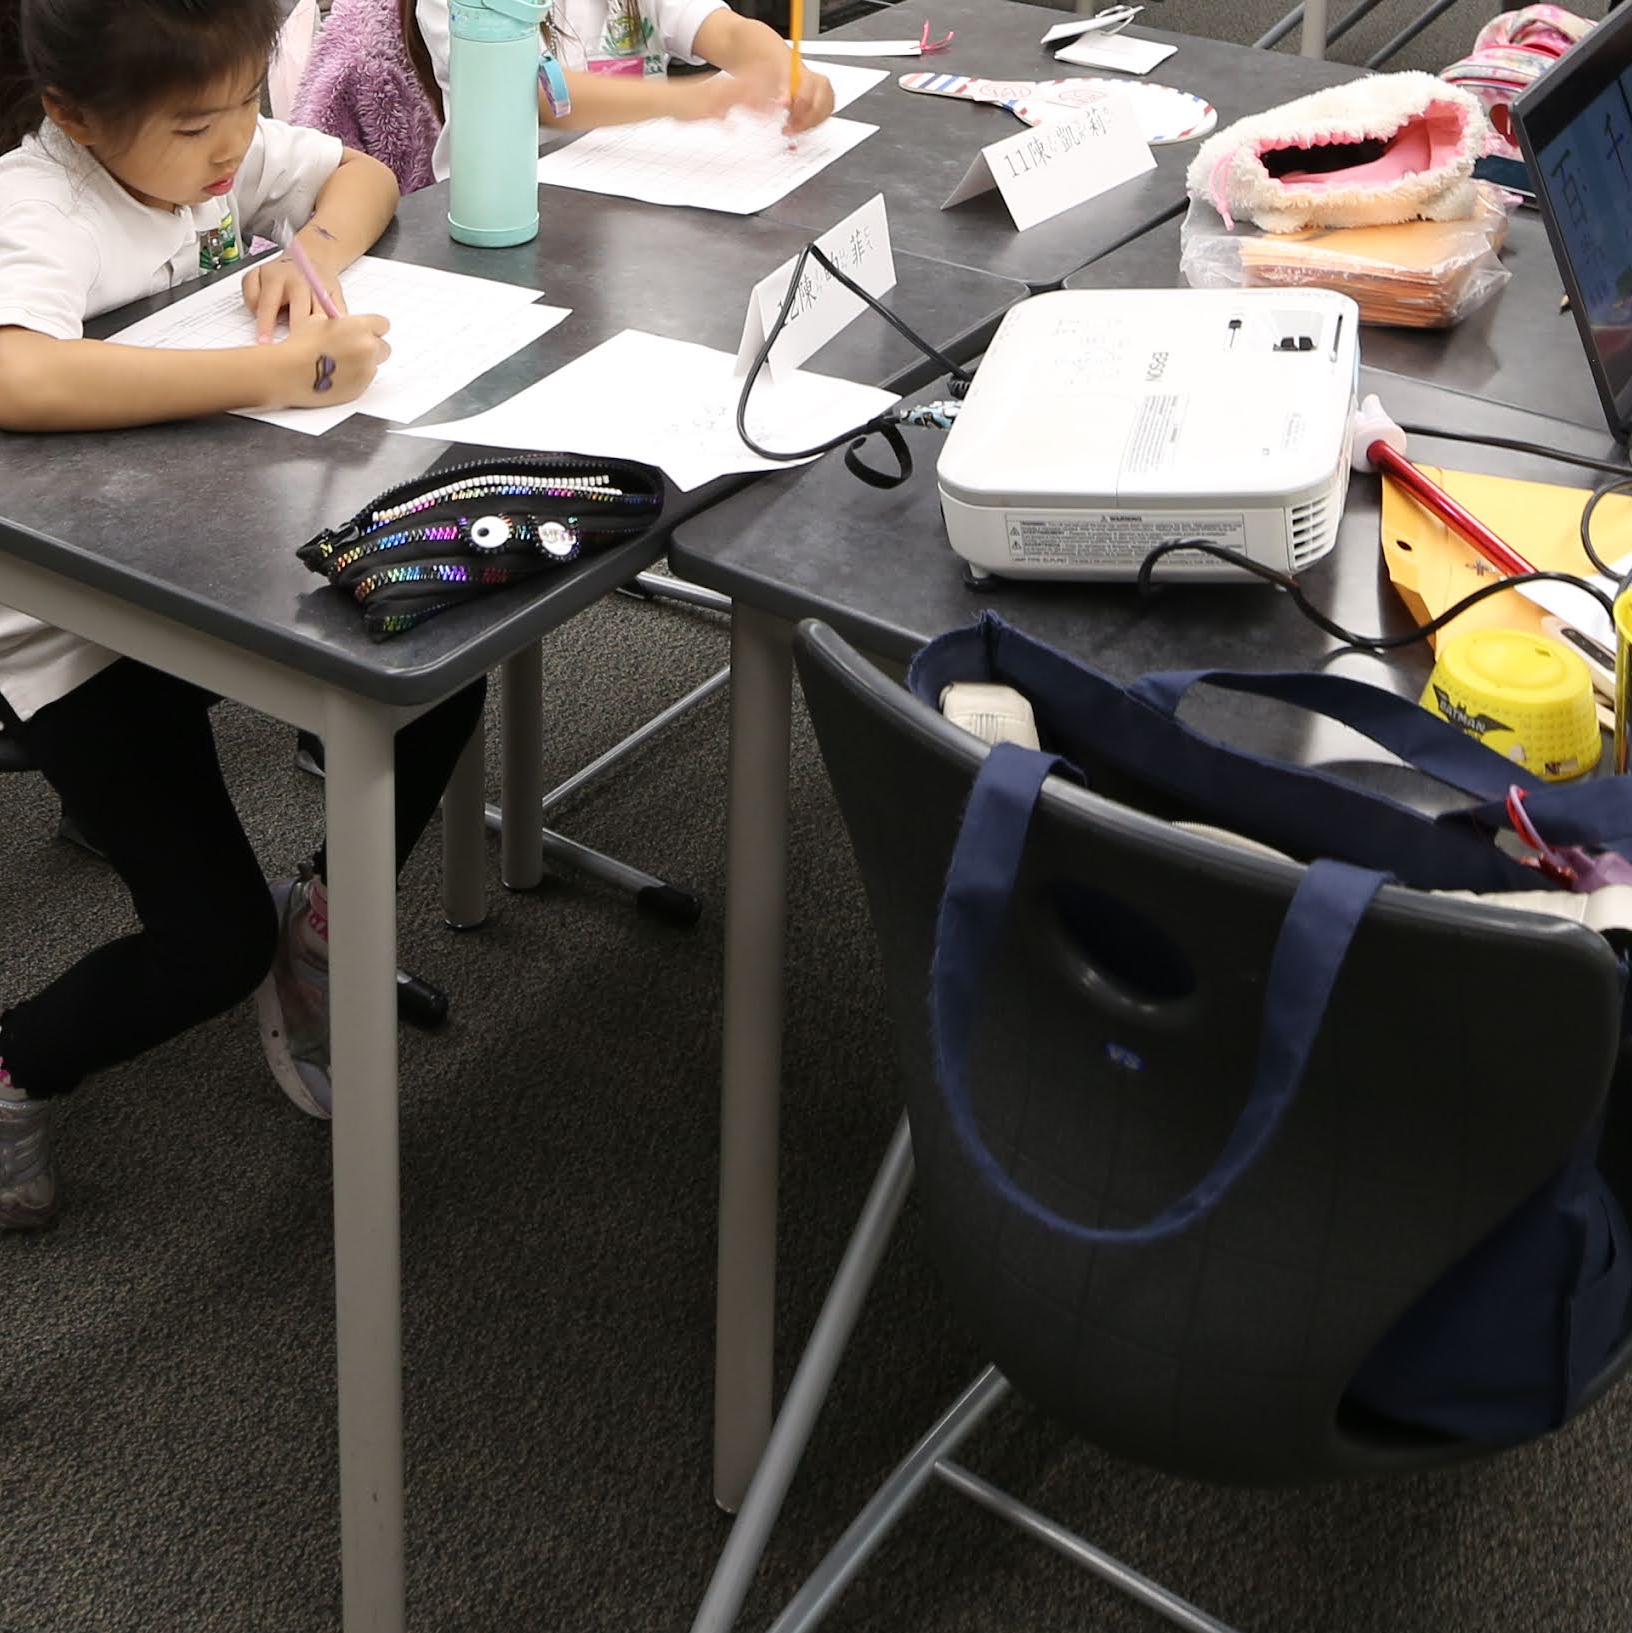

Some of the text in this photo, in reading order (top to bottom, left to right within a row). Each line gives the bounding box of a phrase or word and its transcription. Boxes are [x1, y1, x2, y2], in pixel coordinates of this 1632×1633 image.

[1003, 150, 1033, 178] 11
[1146, 351, 1170, 382] EPSON
[1109, 515, 1143, 523] WARNING
[1439, 698, 1487, 733] BATMAN
